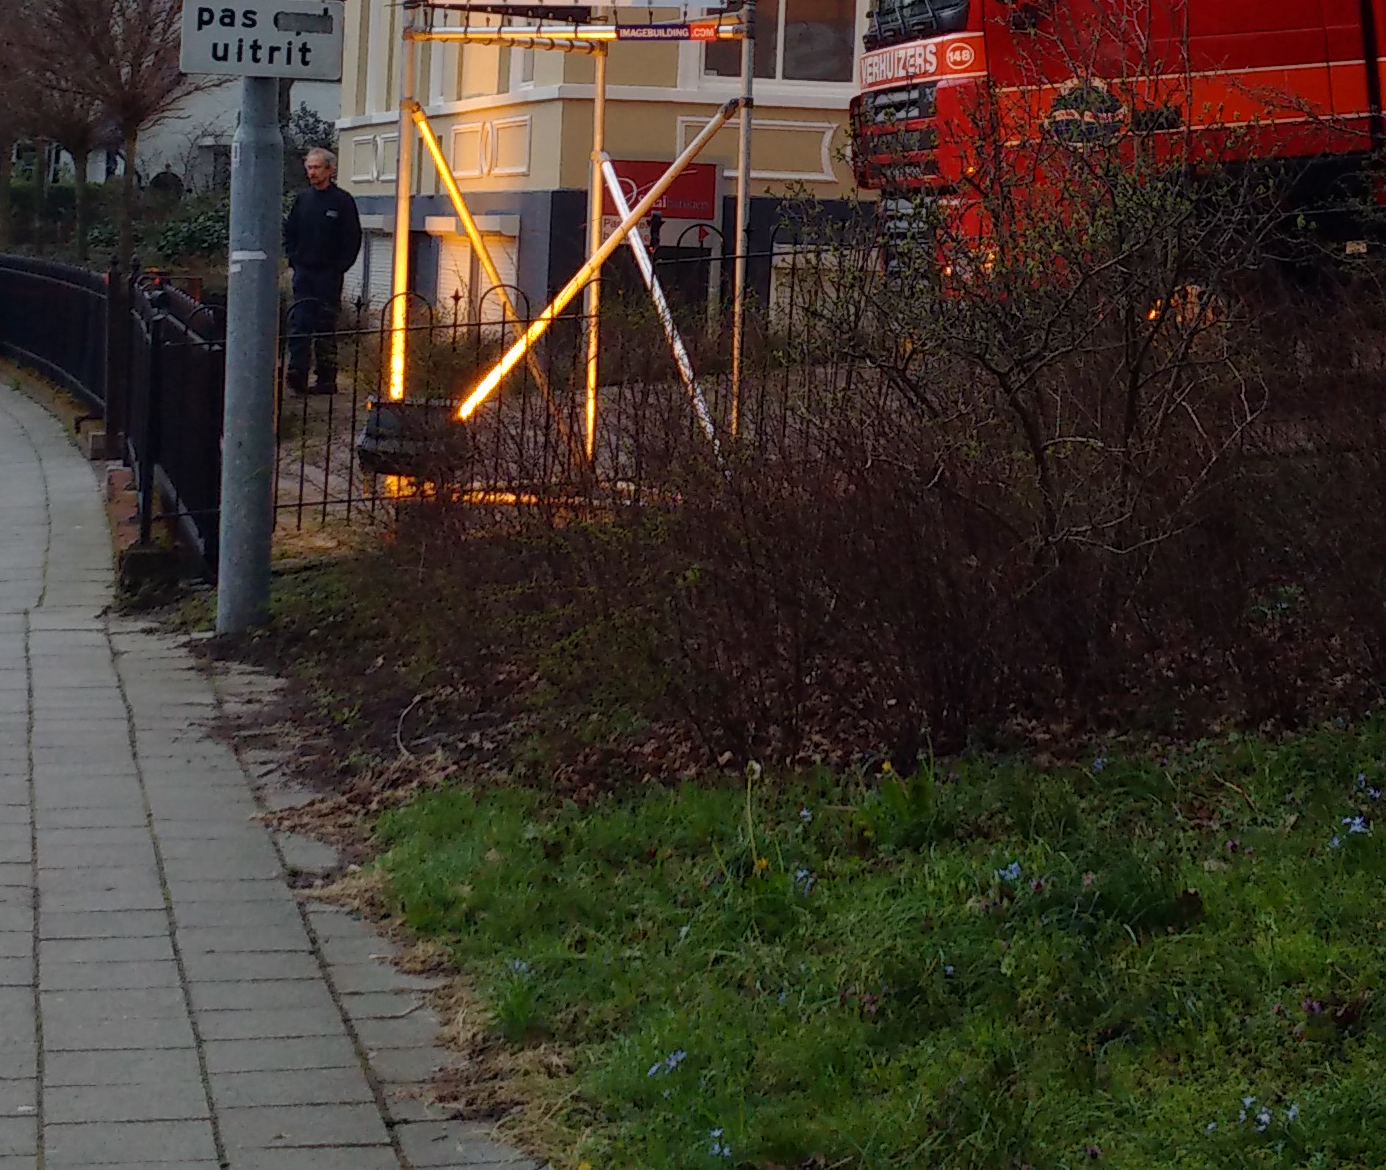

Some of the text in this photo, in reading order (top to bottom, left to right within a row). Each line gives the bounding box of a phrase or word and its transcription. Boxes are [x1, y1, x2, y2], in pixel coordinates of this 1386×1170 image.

[197, 6, 258, 31] pas
[211, 37, 312, 67] uitrit
[861, 44, 938, 85] VERHUIZERS
